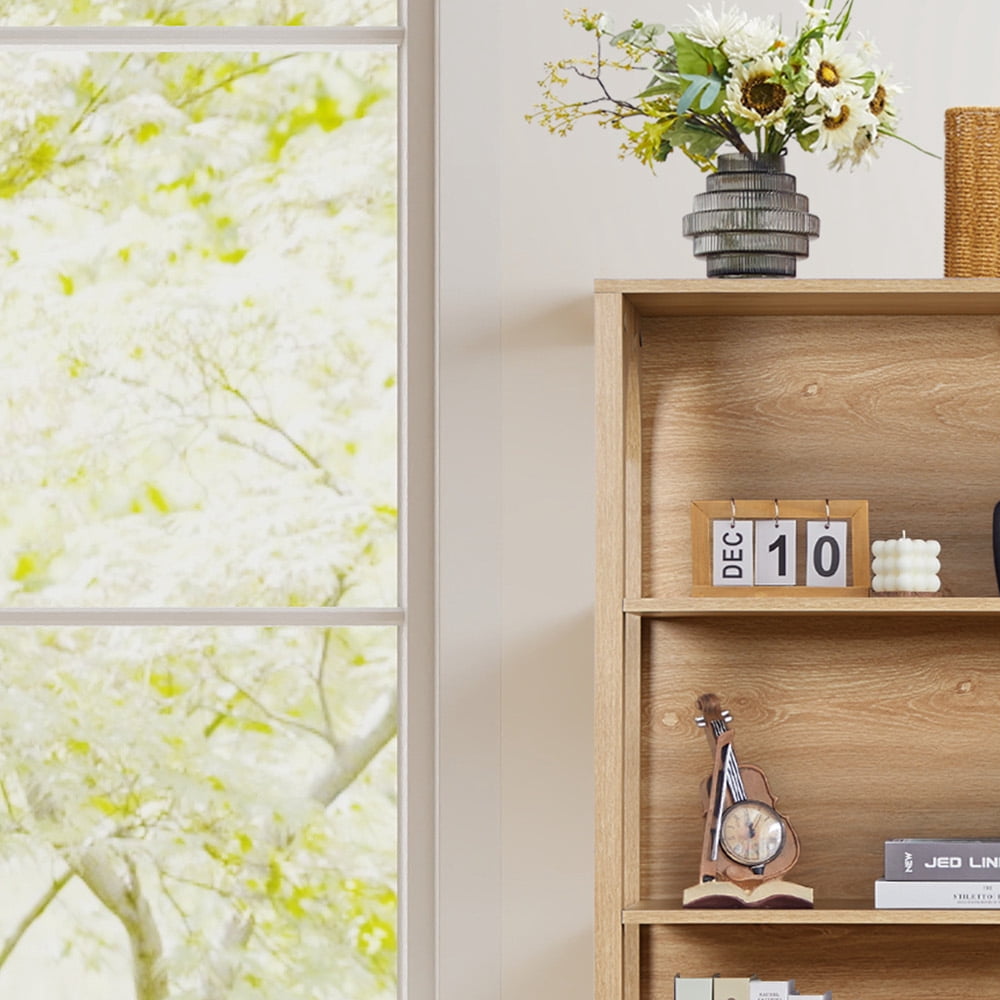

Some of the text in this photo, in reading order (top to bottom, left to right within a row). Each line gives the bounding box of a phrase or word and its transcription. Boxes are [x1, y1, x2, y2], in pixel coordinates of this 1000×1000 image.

[722, 532, 743, 579] DEC
[905, 852, 913, 873] NEW
[924, 857, 962, 869] JED
